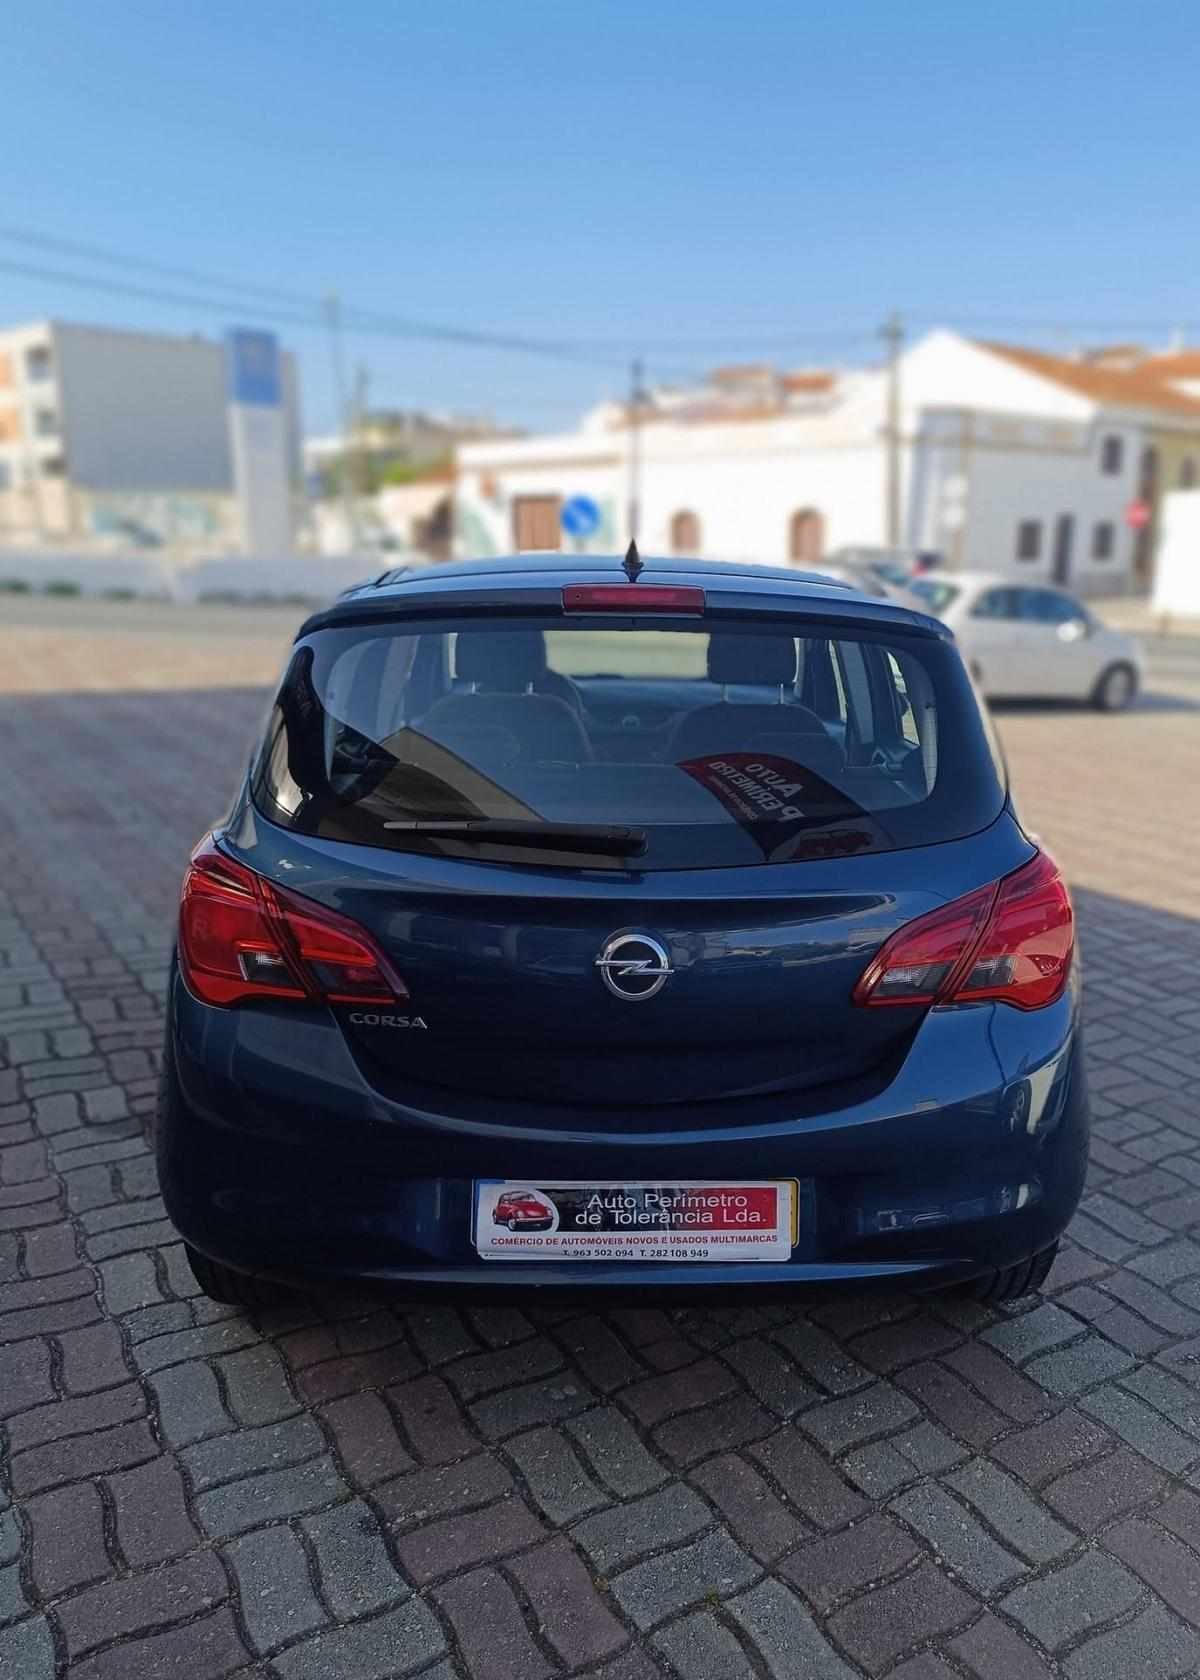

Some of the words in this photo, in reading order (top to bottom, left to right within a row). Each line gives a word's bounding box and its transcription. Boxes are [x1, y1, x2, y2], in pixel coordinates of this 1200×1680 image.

[349, 1012, 428, 1030] CORSA
[587, 1194, 637, 1209] Auto
[645, 1193, 748, 1208] Perímetro
[576, 1210, 602, 1225] de
[610, 1208, 713, 1225] Tolerância
[723, 1208, 767, 1223] Lda.
[491, 1236, 544, 1246] COMÉRCIO
[546, 1237, 559, 1246] DE
[561, 1236, 625, 1245] AUTOMÓVEIS
[626, 1236, 659, 1245] NOVOS
[662, 1236, 668, 1245] E
[670, 1235, 708, 1244] USADOS
[711, 1235, 778, 1244] MULTIMARCAS
[573, 1249, 593, 1257] 963
[594, 1249, 612, 1257] 502
[615, 1249, 634, 1257] 094
[640, 1249, 647, 1257] T.
[650, 1249, 668, 1257] 282
[671, 1249, 688, 1258] 108
[690, 1249, 709, 1257] 949
